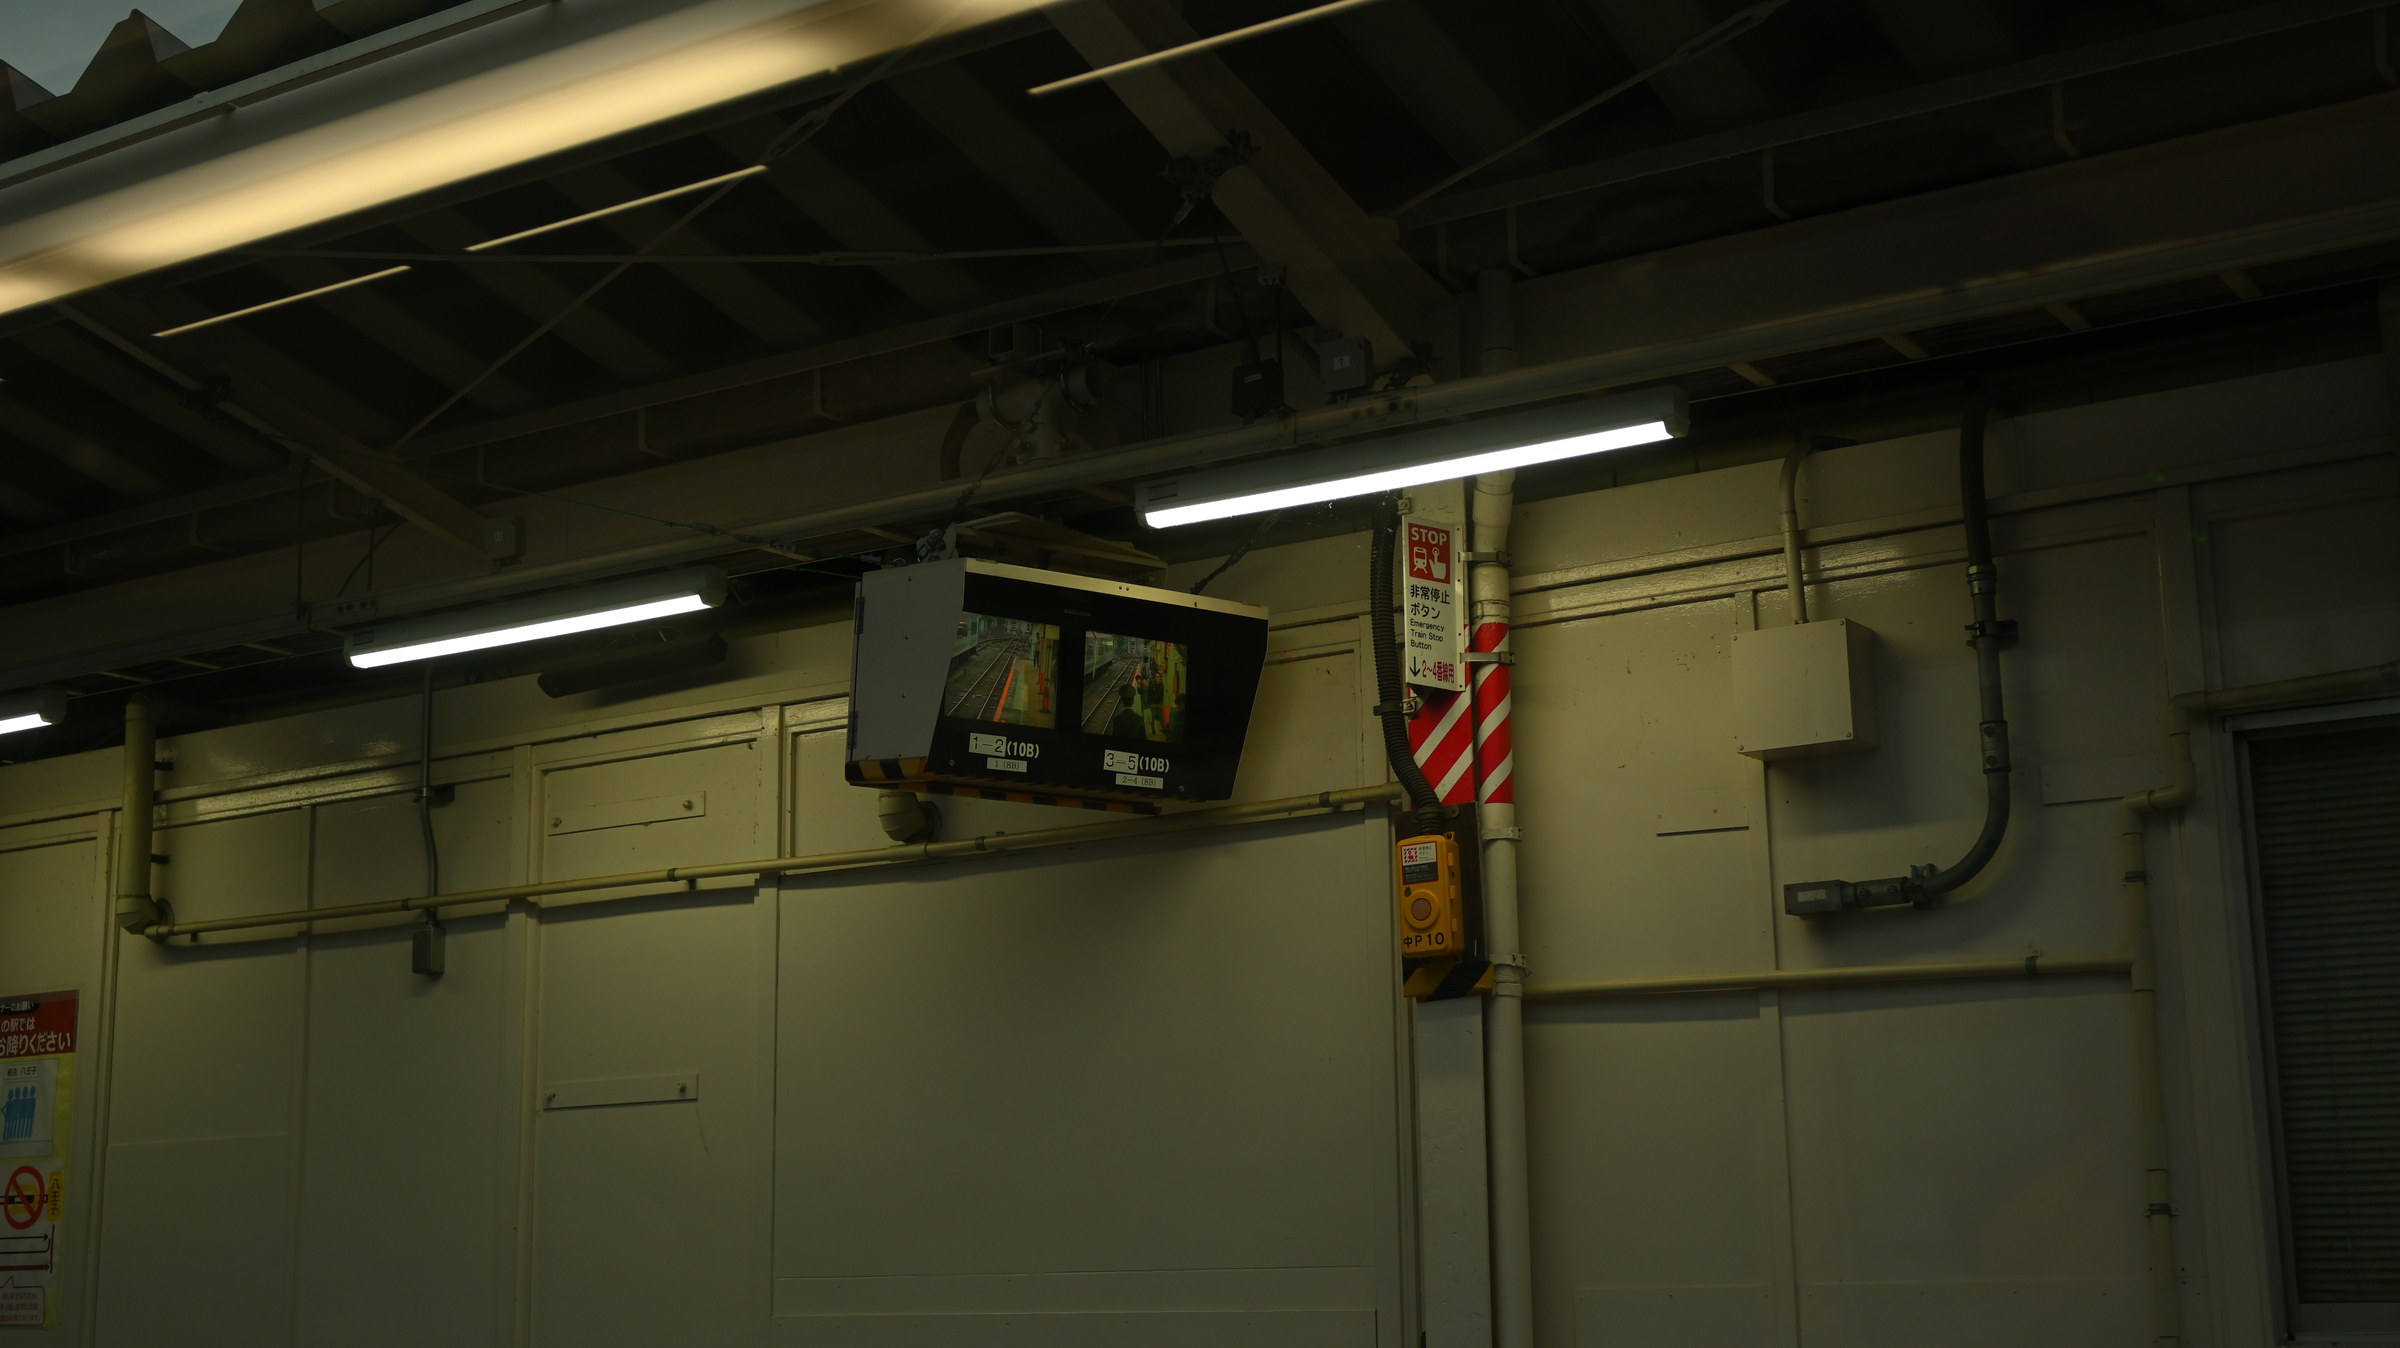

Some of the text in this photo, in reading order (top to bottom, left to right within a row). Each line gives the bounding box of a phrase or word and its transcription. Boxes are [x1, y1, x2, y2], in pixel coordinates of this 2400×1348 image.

[1411, 527, 1448, 547] STOP
[1410, 584, 1451, 605] 非常停止
[1410, 602, 1441, 619] ボタン
[1410, 618, 1445, 632] Emergency
[1410, 628, 1444, 643] Train Stop
[1410, 639, 1433, 650] Button
[0, 1017, 36, 1032] の駅では
[50, 1178, 61, 1216] 八王子
